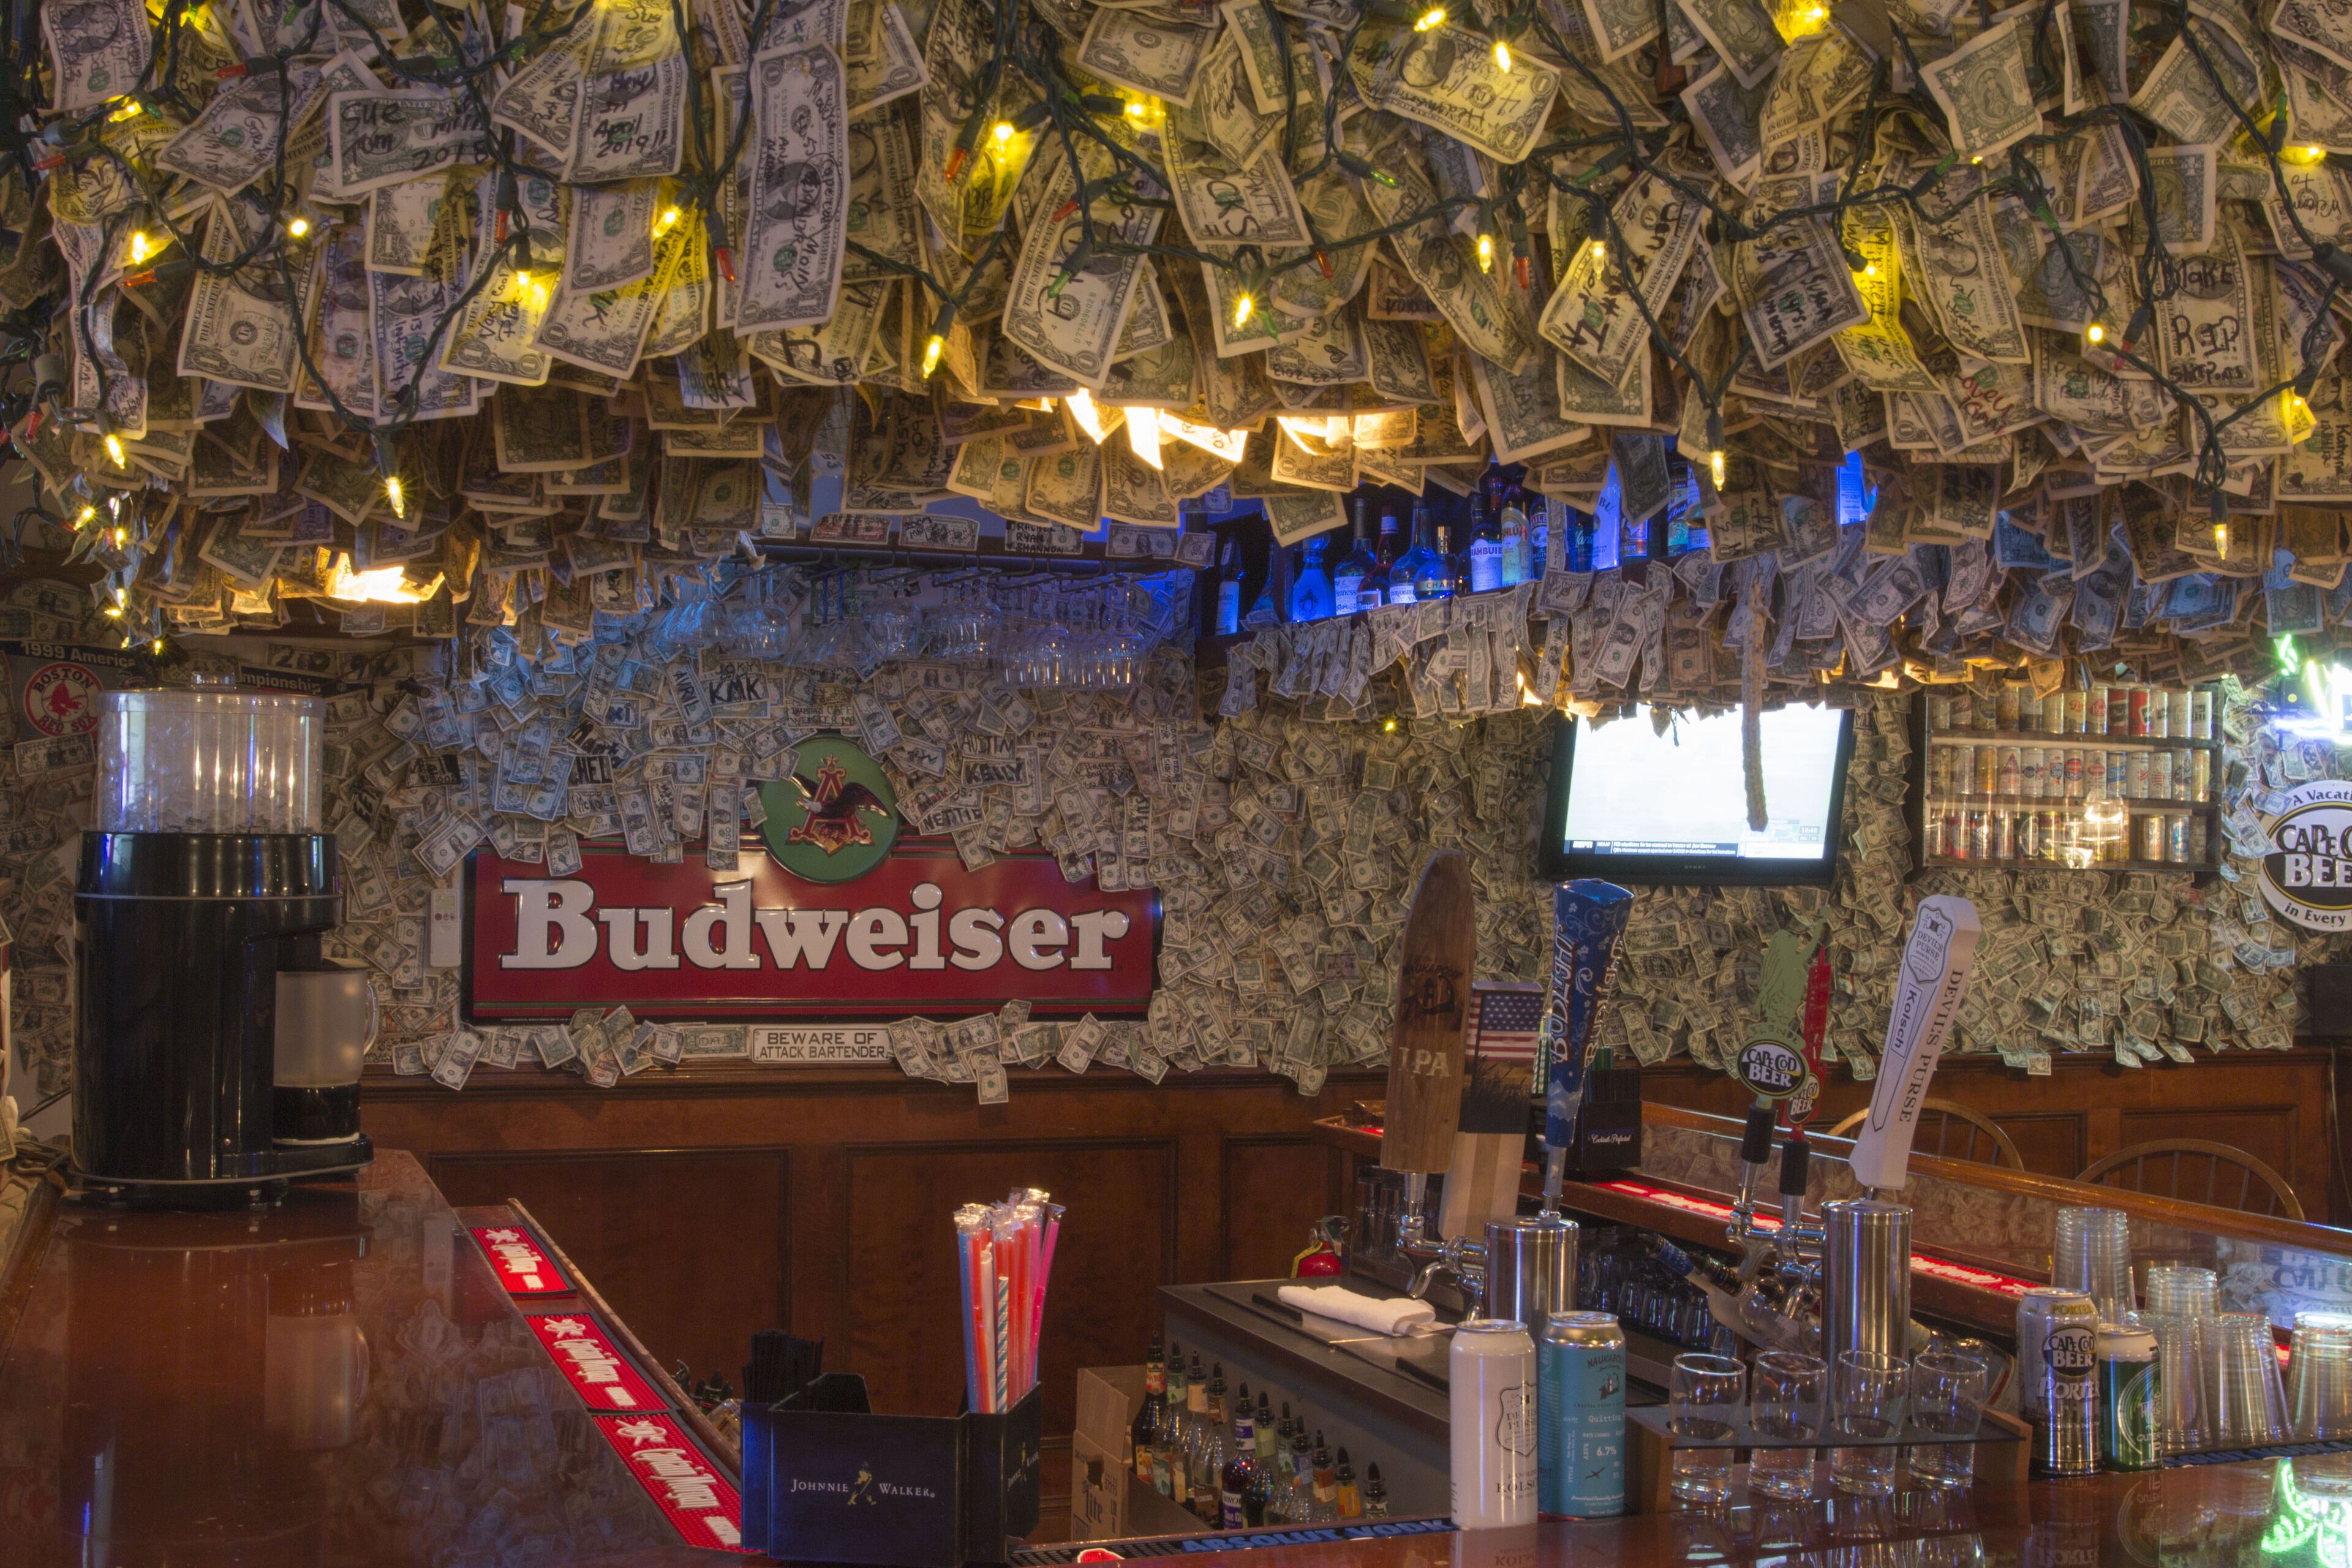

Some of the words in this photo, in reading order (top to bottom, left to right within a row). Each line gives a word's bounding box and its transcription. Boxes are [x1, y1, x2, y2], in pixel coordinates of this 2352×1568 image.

[341, 103, 407, 134] Sue
[412, 143, 490, 172] 2018
[390, 320, 407, 382] Infinity
[1016, 532, 1045, 543] RYAN
[1016, 543, 1065, 554] SHANNON
[21, 643, 66, 660] 1999
[70, 647, 137, 668] America
[32, 668, 94, 693] BOSTON
[37, 715, 65, 734] RED
[70, 710, 96, 733] SOX
[964, 760, 1024, 783] KELLY
[2293, 795, 2304, 807] A
[2307, 789, 2352, 801] Vacati
[2276, 824, 2339, 858] CAPE
[2284, 854, 2352, 888] BEE
[499, 878, 1131, 971] Budweiser
[2283, 902, 2299, 917] in
[2304, 910, 2346, 927] Every
[1915, 940, 1941, 962] PURSE
[1917, 930, 1944, 953] DEVIL'S
[767, 1033, 848, 1046] BEWARE
[854, 1033, 877, 1046] OF
[760, 1046, 805, 1059] ATTACK
[809, 1046, 884, 1059] BARTENDER
[1398, 1046, 1452, 1078] IPA
[1746, 1048, 1774, 1069] CAPE
[1775, 1054, 1797, 1072] COD
[1747, 1063, 1792, 1088] BEER
[1899, 1054, 1933, 1123] PURSE
[1790, 1098, 1813, 1115] BEER
[2048, 1335, 2077, 1351] CAPE
[2078, 1335, 2095, 1354] COD
[2052, 1352, 2094, 1368] BEER
[2037, 1376, 2101, 1400] PORTER
[1596, 1446, 1618, 1457] 6.7%
[790, 1478, 850, 1493] JOHNNIE
[878, 1482, 930, 1498] WALKER
[1181, 1527, 1344, 1553] ABSOLUT
[1344, 1519, 1456, 1539] VODK
